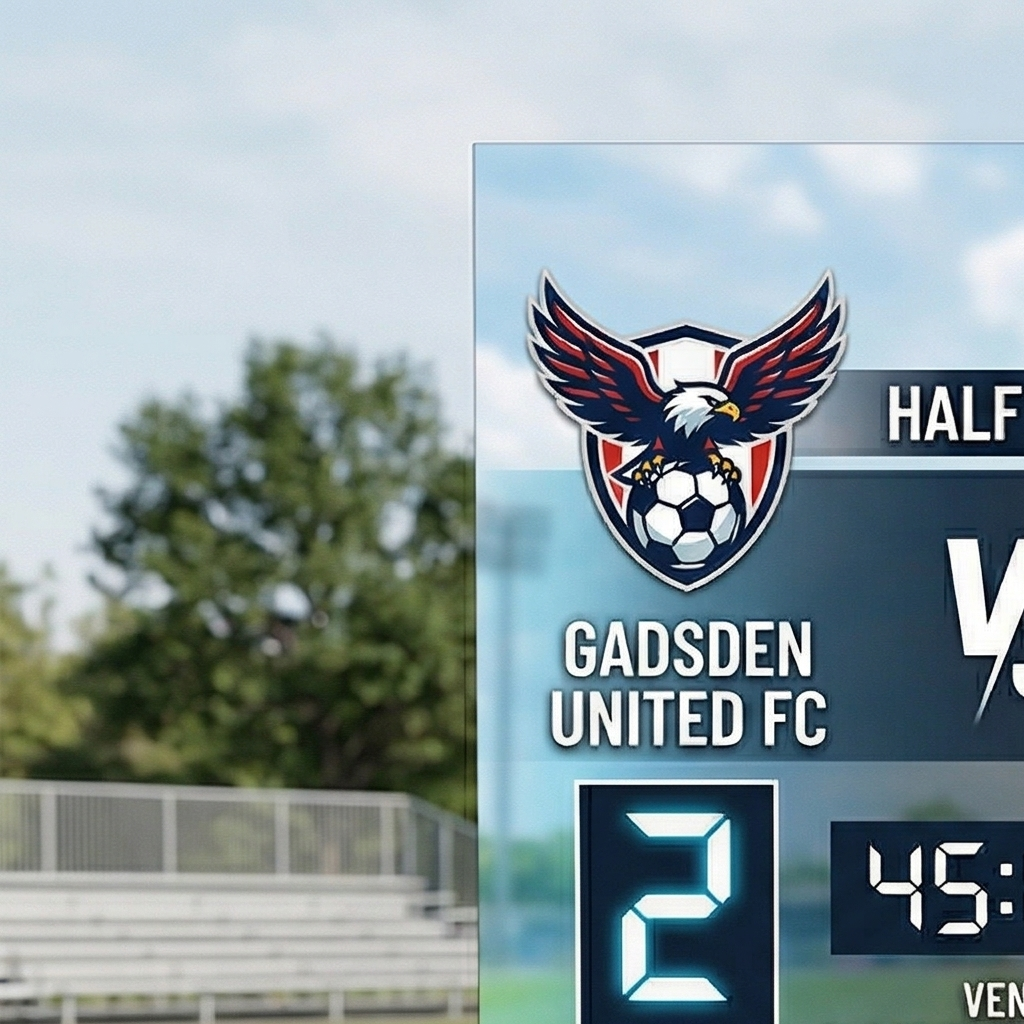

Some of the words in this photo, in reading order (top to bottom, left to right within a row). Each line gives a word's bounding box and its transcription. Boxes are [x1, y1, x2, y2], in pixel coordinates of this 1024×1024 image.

[889, 385, 1022, 441] HALF
[565, 620, 811, 677] GADSDEN
[552, 690, 743, 747] UNITED
[764, 690, 826, 746] FC
[621, 813, 731, 1002] 2
